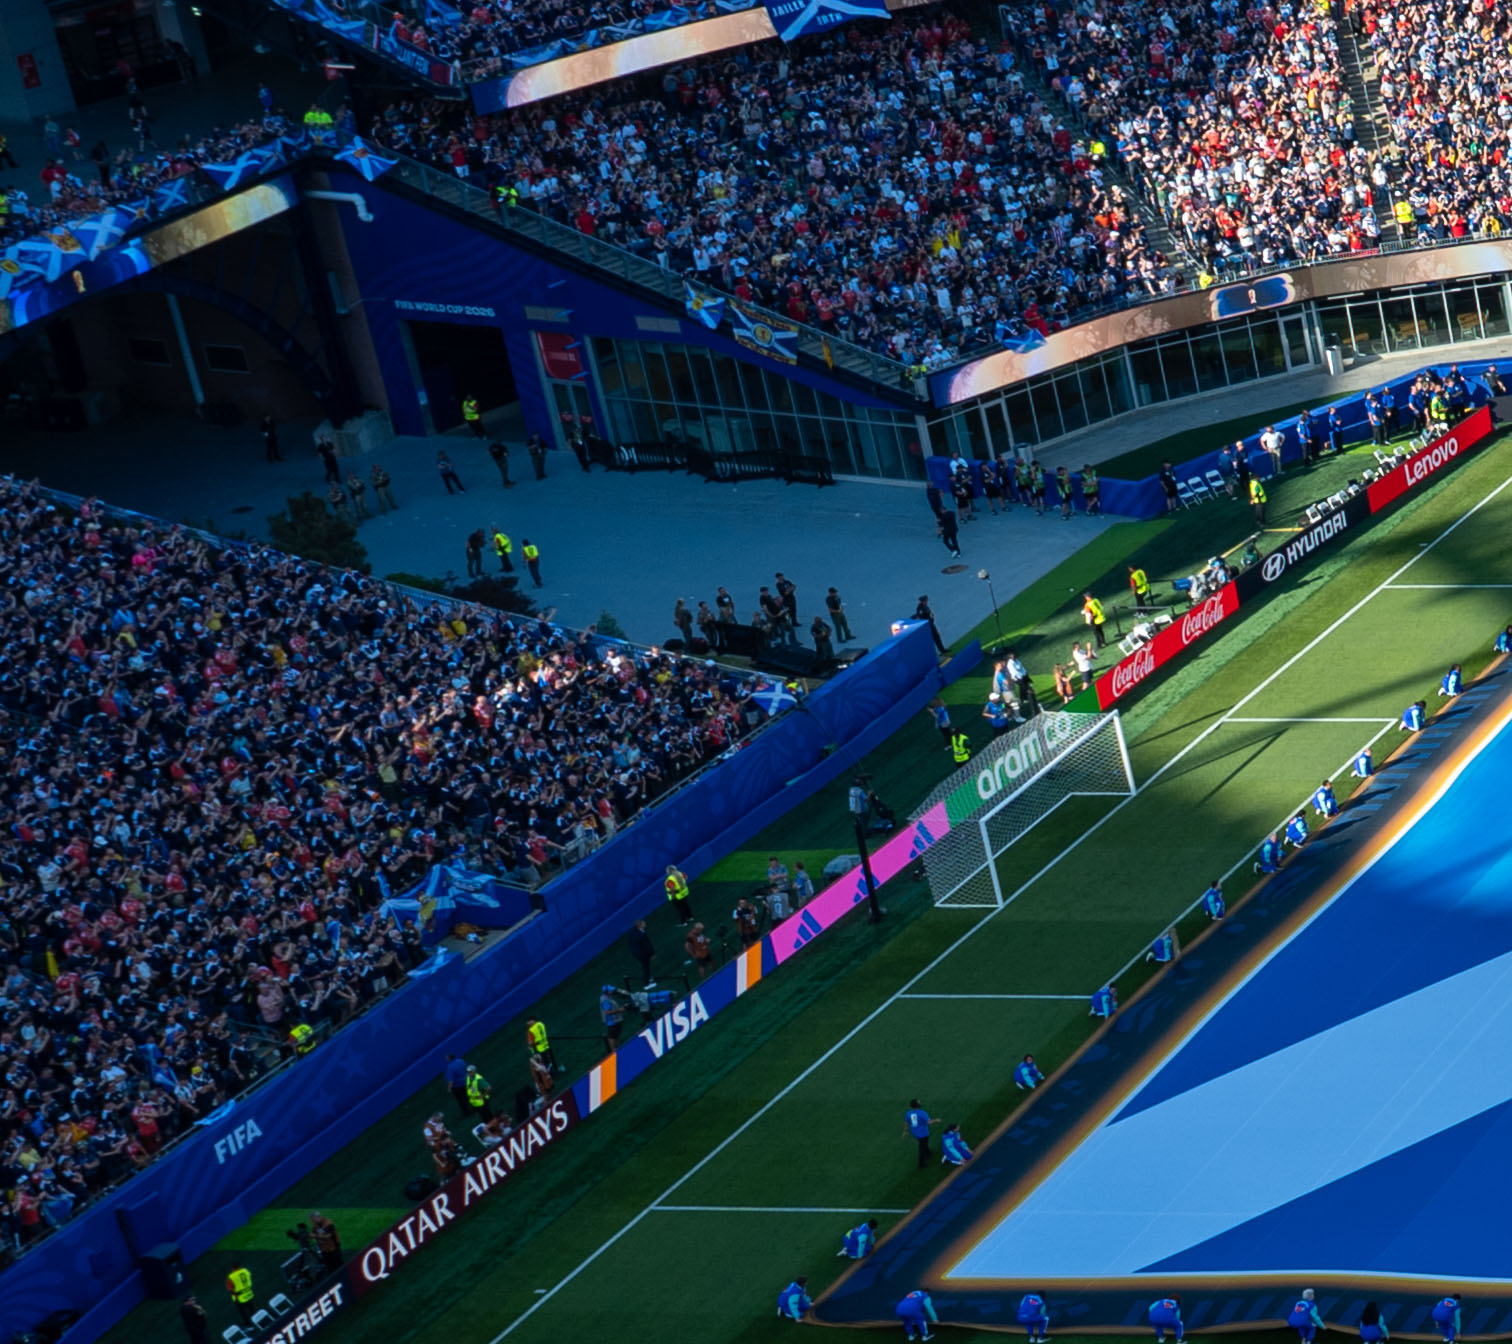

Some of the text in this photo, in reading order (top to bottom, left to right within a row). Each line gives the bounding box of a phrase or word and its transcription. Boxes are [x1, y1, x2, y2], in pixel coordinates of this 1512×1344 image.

[1404, 435, 1459, 487] Lenovo
[1286, 511, 1348, 566] HYUNDAI
[977, 711, 1073, 798] aramco
[638, 990, 710, 1059] VISA
[214, 1118, 263, 1165] FIFA
[362, 1100, 568, 1282] QATAR AIRWAYS
